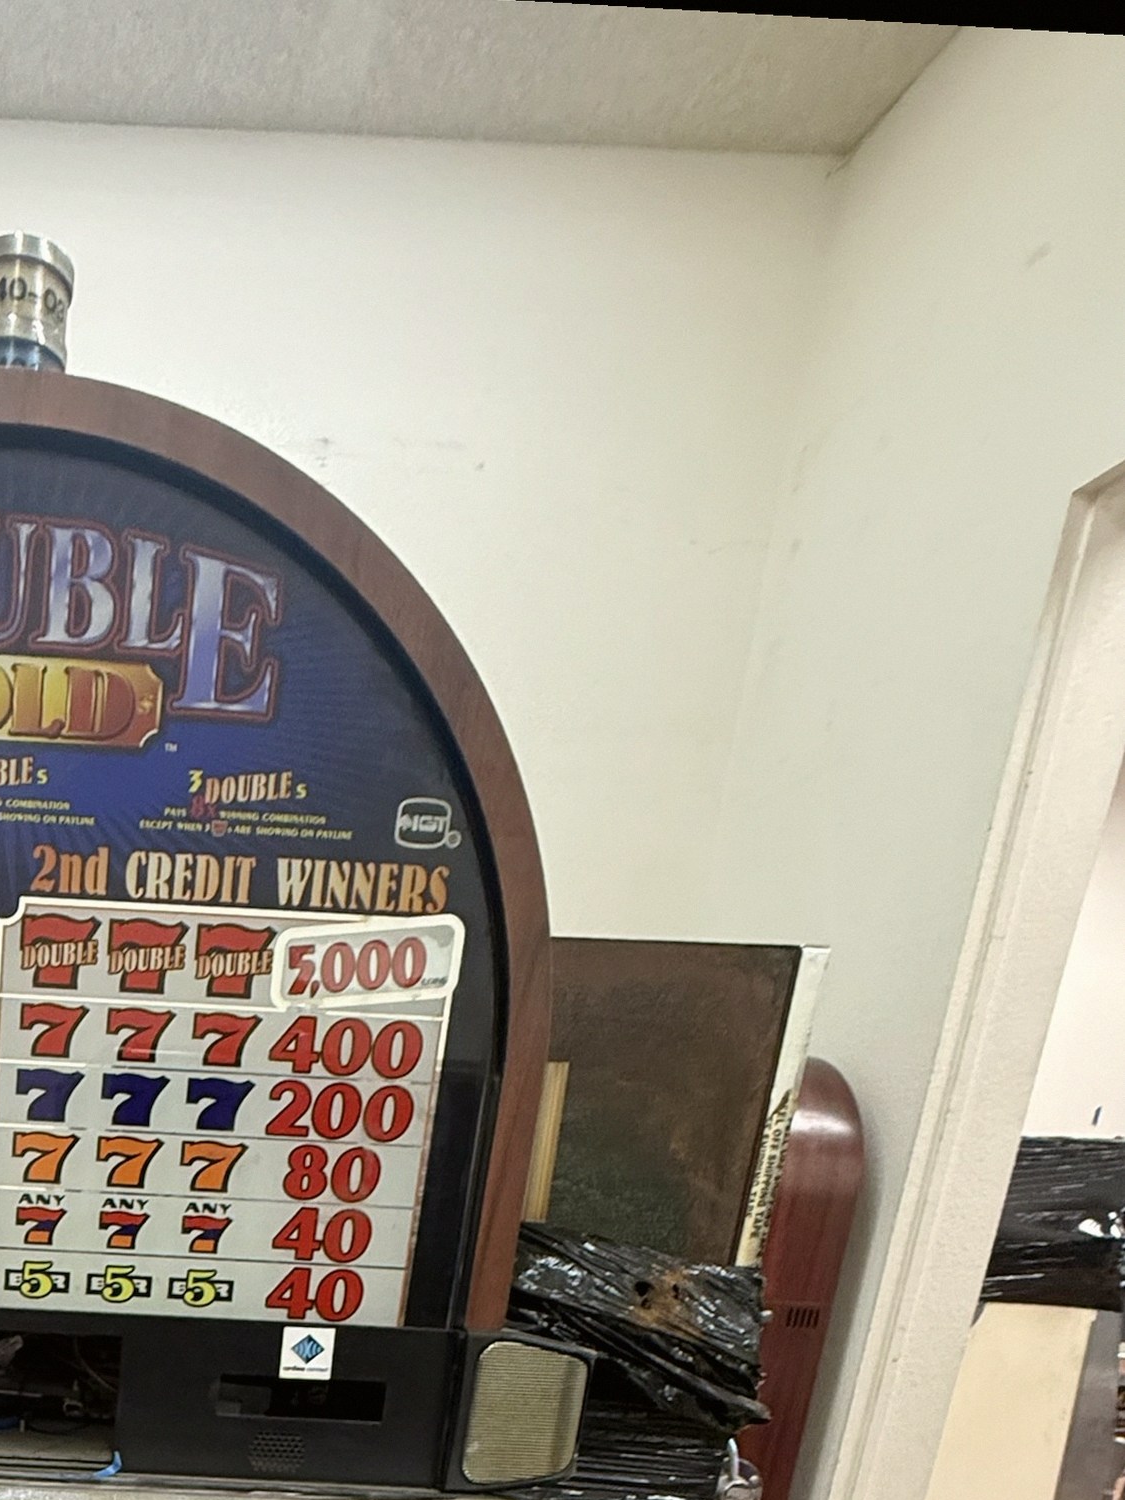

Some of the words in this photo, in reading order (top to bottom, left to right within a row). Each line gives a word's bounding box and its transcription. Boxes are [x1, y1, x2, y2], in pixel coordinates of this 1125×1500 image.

[188, 770, 203, 793] 3
[205, 770, 292, 804] DOUBLE
[30, 843, 110, 895] 2nd
[126, 850, 257, 904] CREDIT
[277, 856, 450, 913] WINNERS
[21, 939, 99, 969] DOUBLE
[108, 944, 186, 975] DOUBLE
[196, 949, 273, 979] DOUBLE
[269, 1015, 423, 1079] 400
[265, 1079, 415, 1142] 200
[282, 1144, 381, 1203] 80
[19, 1193, 66, 1206] ANY
[101, 1197, 149, 1210] ANY
[184, 1202, 232, 1215] ANY
[273, 1207, 372, 1264] 40
[265, 1267, 365, 1321] 40
